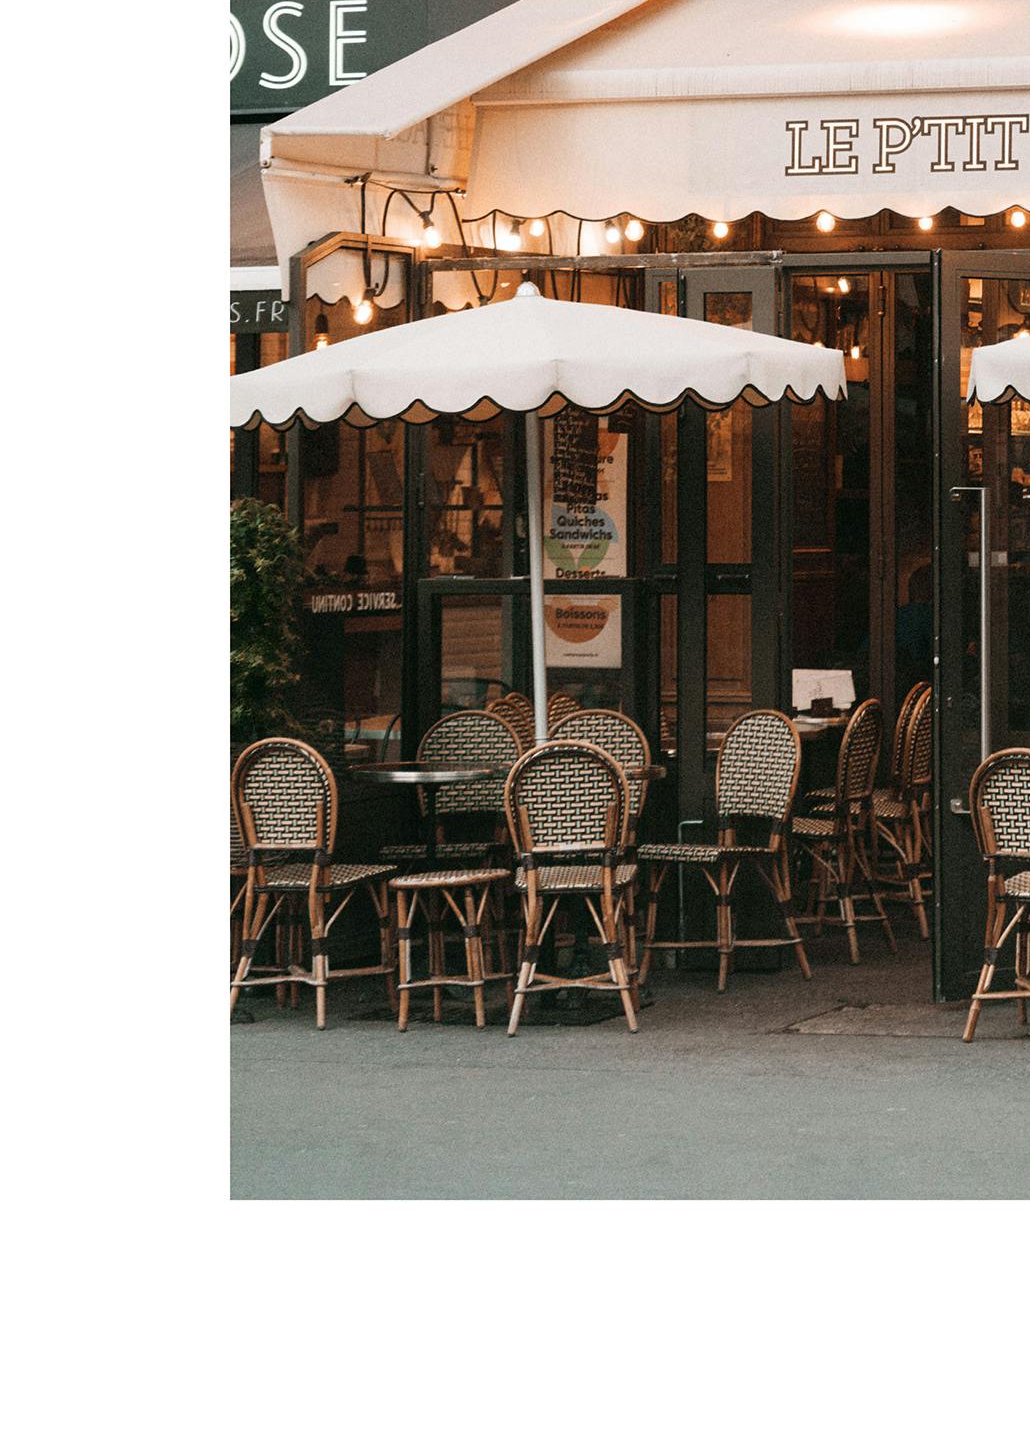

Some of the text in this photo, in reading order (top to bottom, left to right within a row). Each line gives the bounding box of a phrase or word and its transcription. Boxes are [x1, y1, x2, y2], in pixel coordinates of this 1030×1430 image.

[785, 120, 859, 176] LE
[872, 114, 1029, 174] P'TIT
[567, 503, 595, 514] Pitas
[557, 515, 605, 527] Quiches
[550, 528, 612, 540] Sandwichs
[555, 608, 606, 620] Boissons
